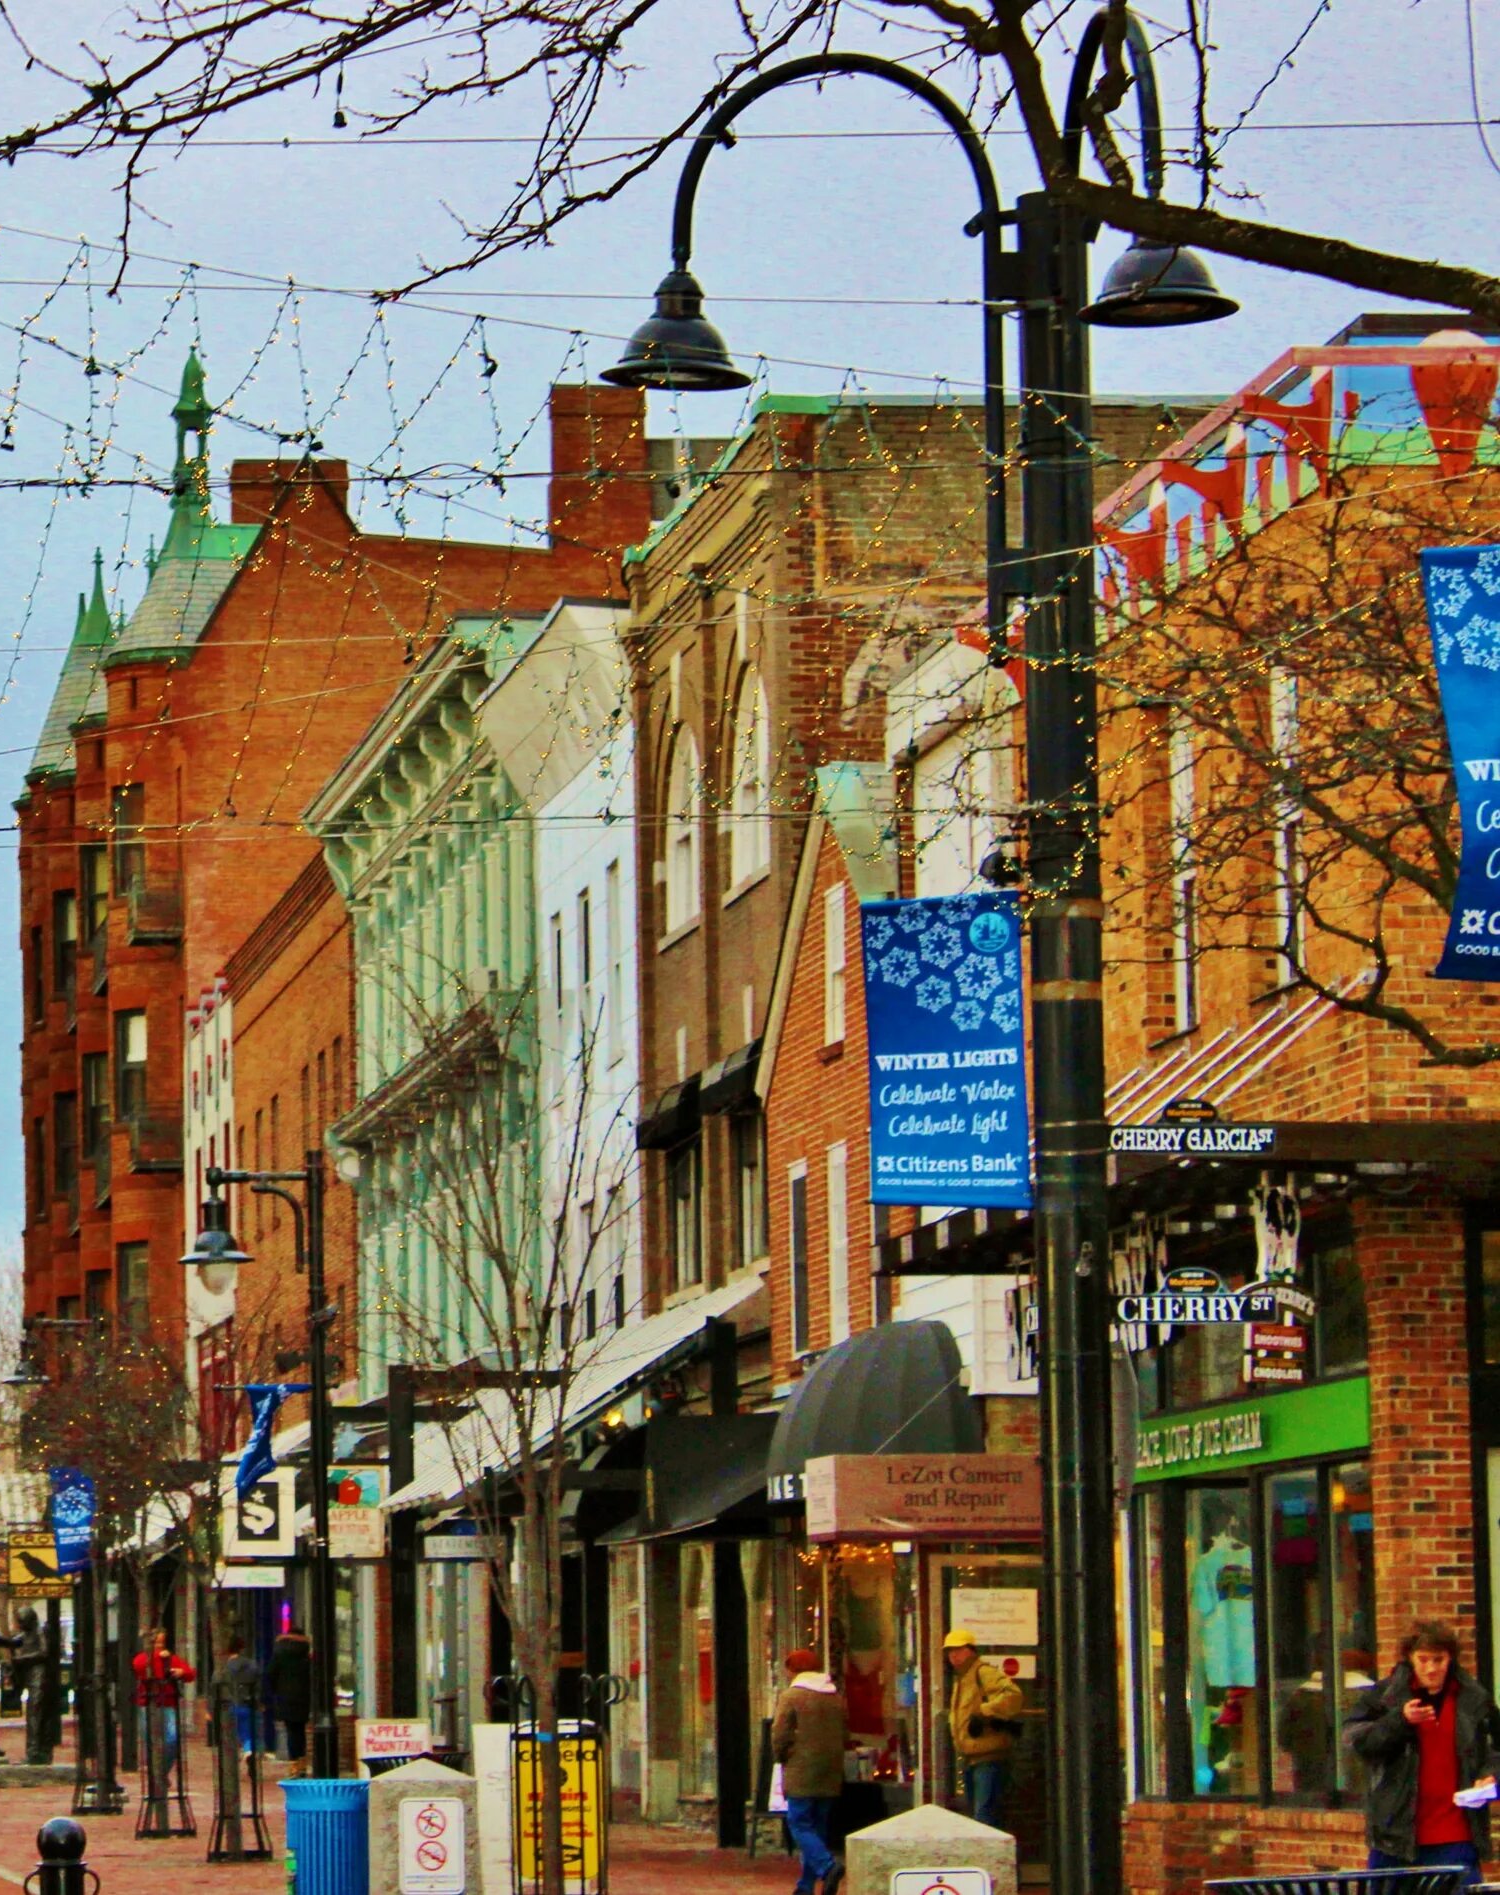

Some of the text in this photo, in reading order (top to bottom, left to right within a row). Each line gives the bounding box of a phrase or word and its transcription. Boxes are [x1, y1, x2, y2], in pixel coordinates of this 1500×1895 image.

[875, 1048, 1018, 1072] WINTER LIGHTS
[880, 1079, 1016, 1107] Celebrate Winter
[888, 1109, 1008, 1143] Celebrate Light
[1110, 1127, 1274, 1151] CHERRY GARCIA ST
[896, 1155, 969, 1173] Citizens
[1117, 1296, 1273, 1323] CHERRY ST
[1254, 1367, 1303, 1380] CHOCOLATE
[950, 1466, 1024, 1484] Camera
[904, 1487, 1009, 1511] and Repair
[12, 1535, 53, 1545] CRO
[367, 1724, 412, 1738] APPLE
[365, 1737, 424, 1753] MOUNTAIN
